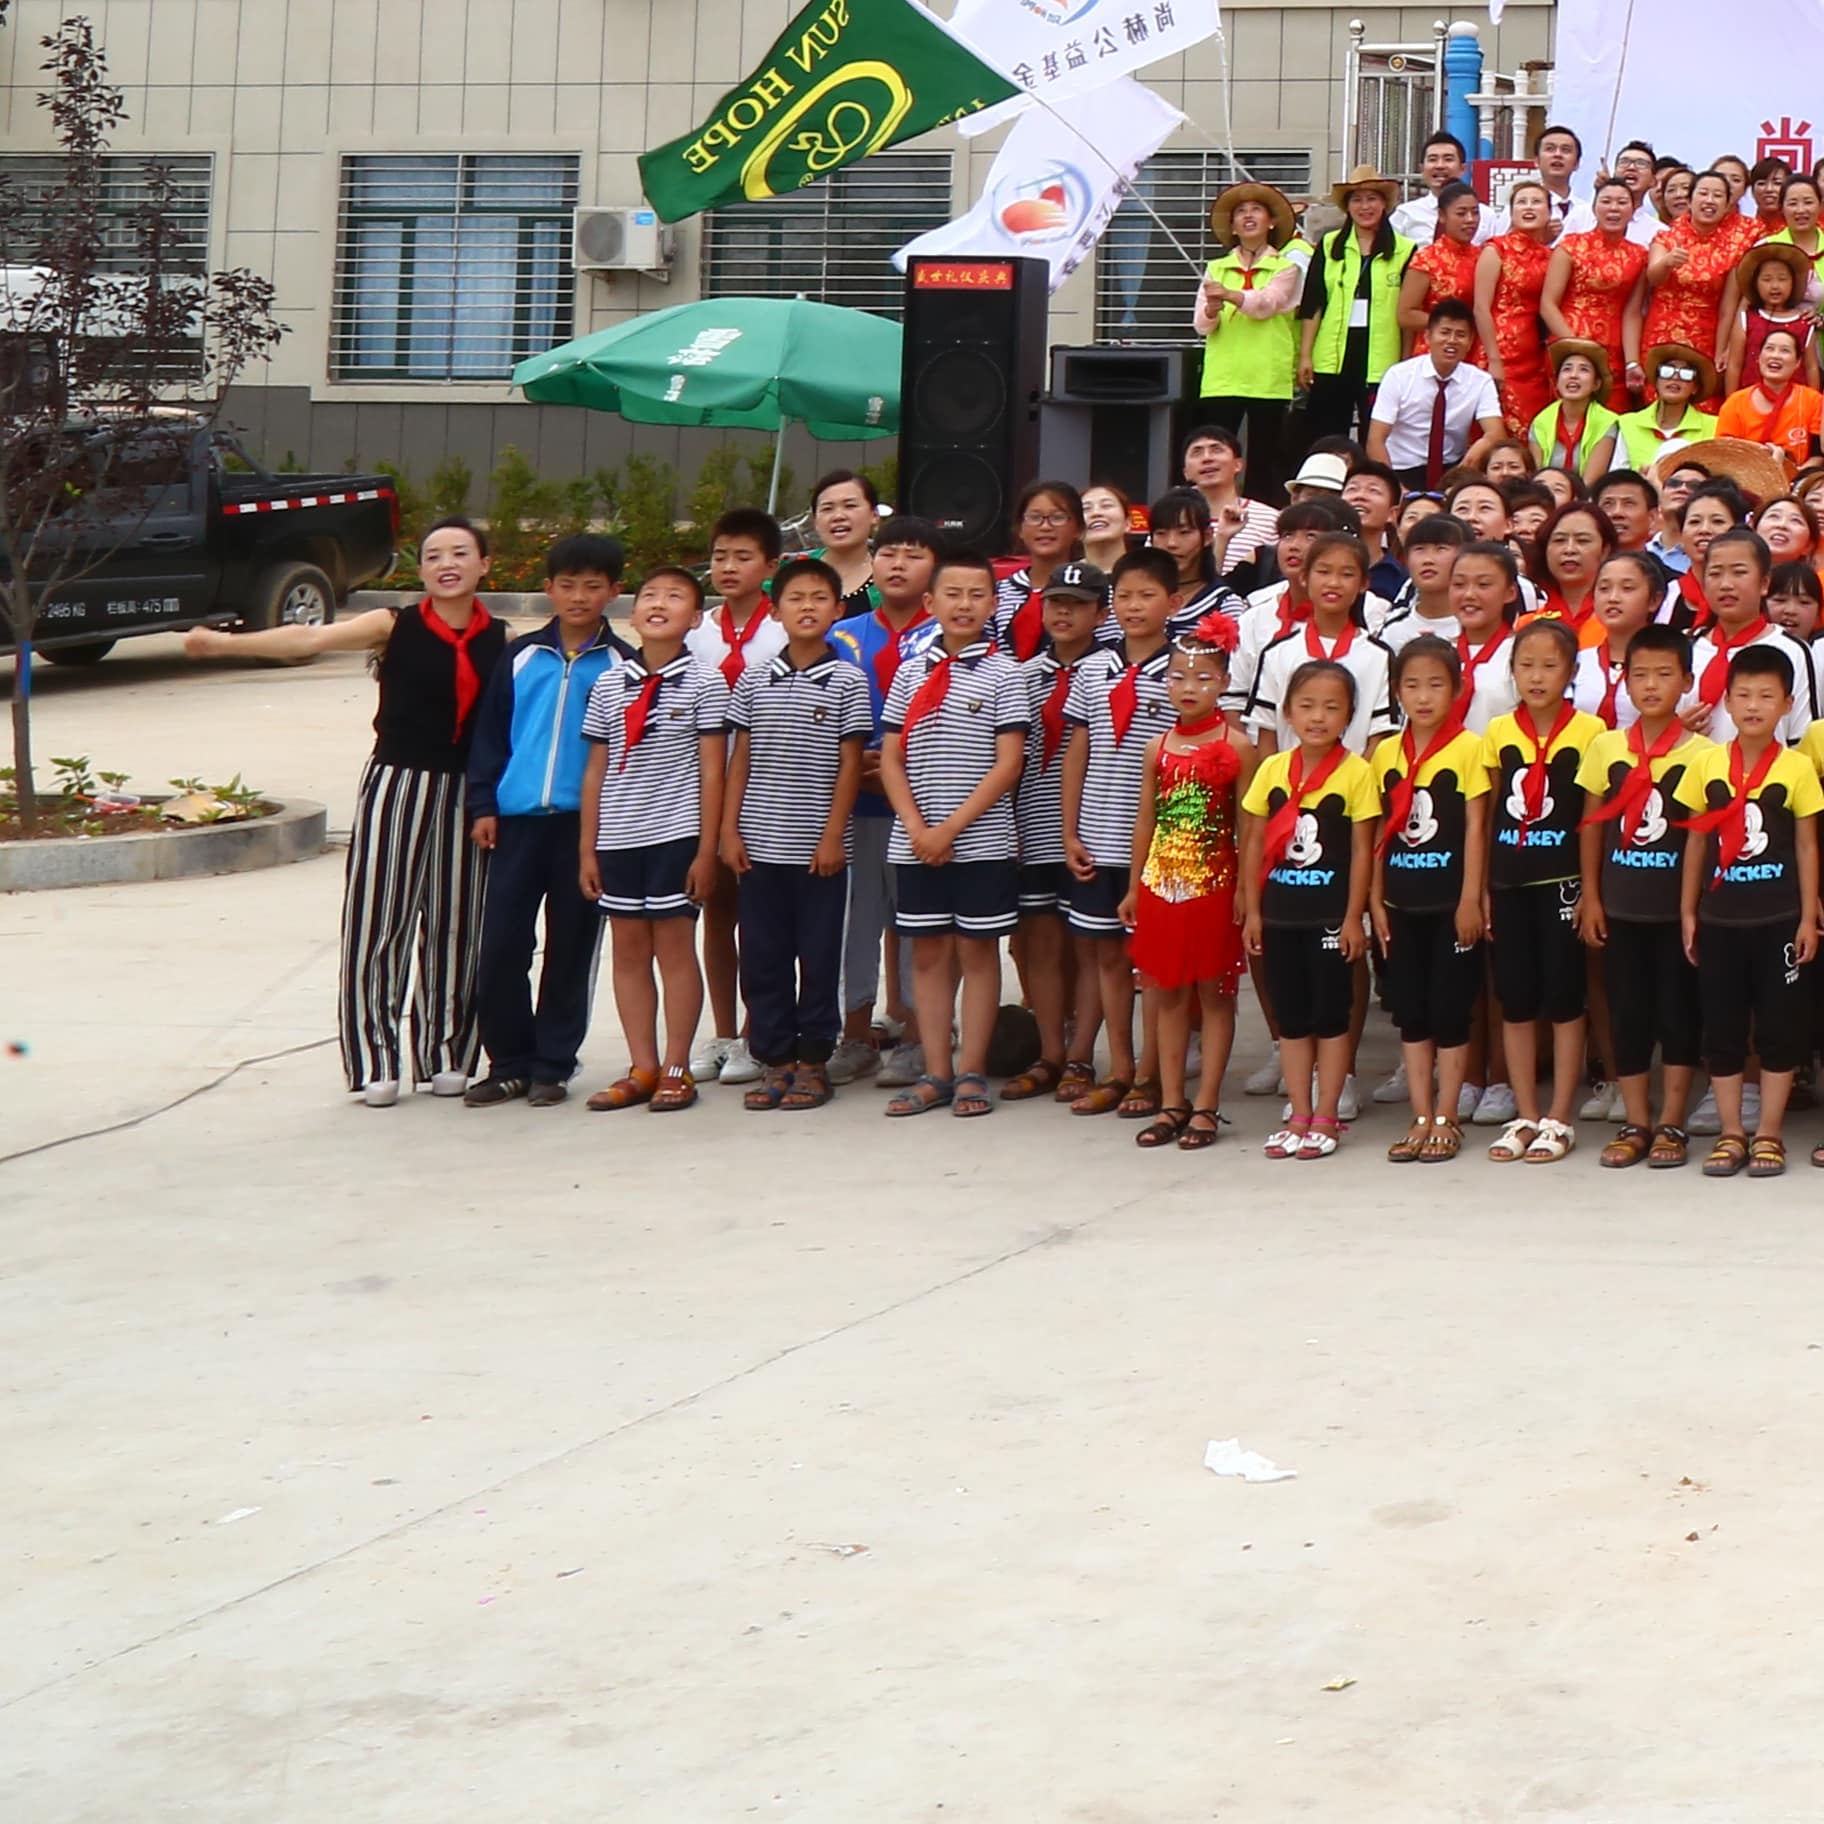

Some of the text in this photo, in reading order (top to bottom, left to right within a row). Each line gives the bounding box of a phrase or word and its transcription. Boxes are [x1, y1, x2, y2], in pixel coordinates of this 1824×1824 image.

[1390, 851, 1452, 869] MICKEY
[1612, 849, 1679, 868] MICKEY
[1268, 869, 1335, 886] MICKEY
[1714, 863, 1784, 882] MICKEY
